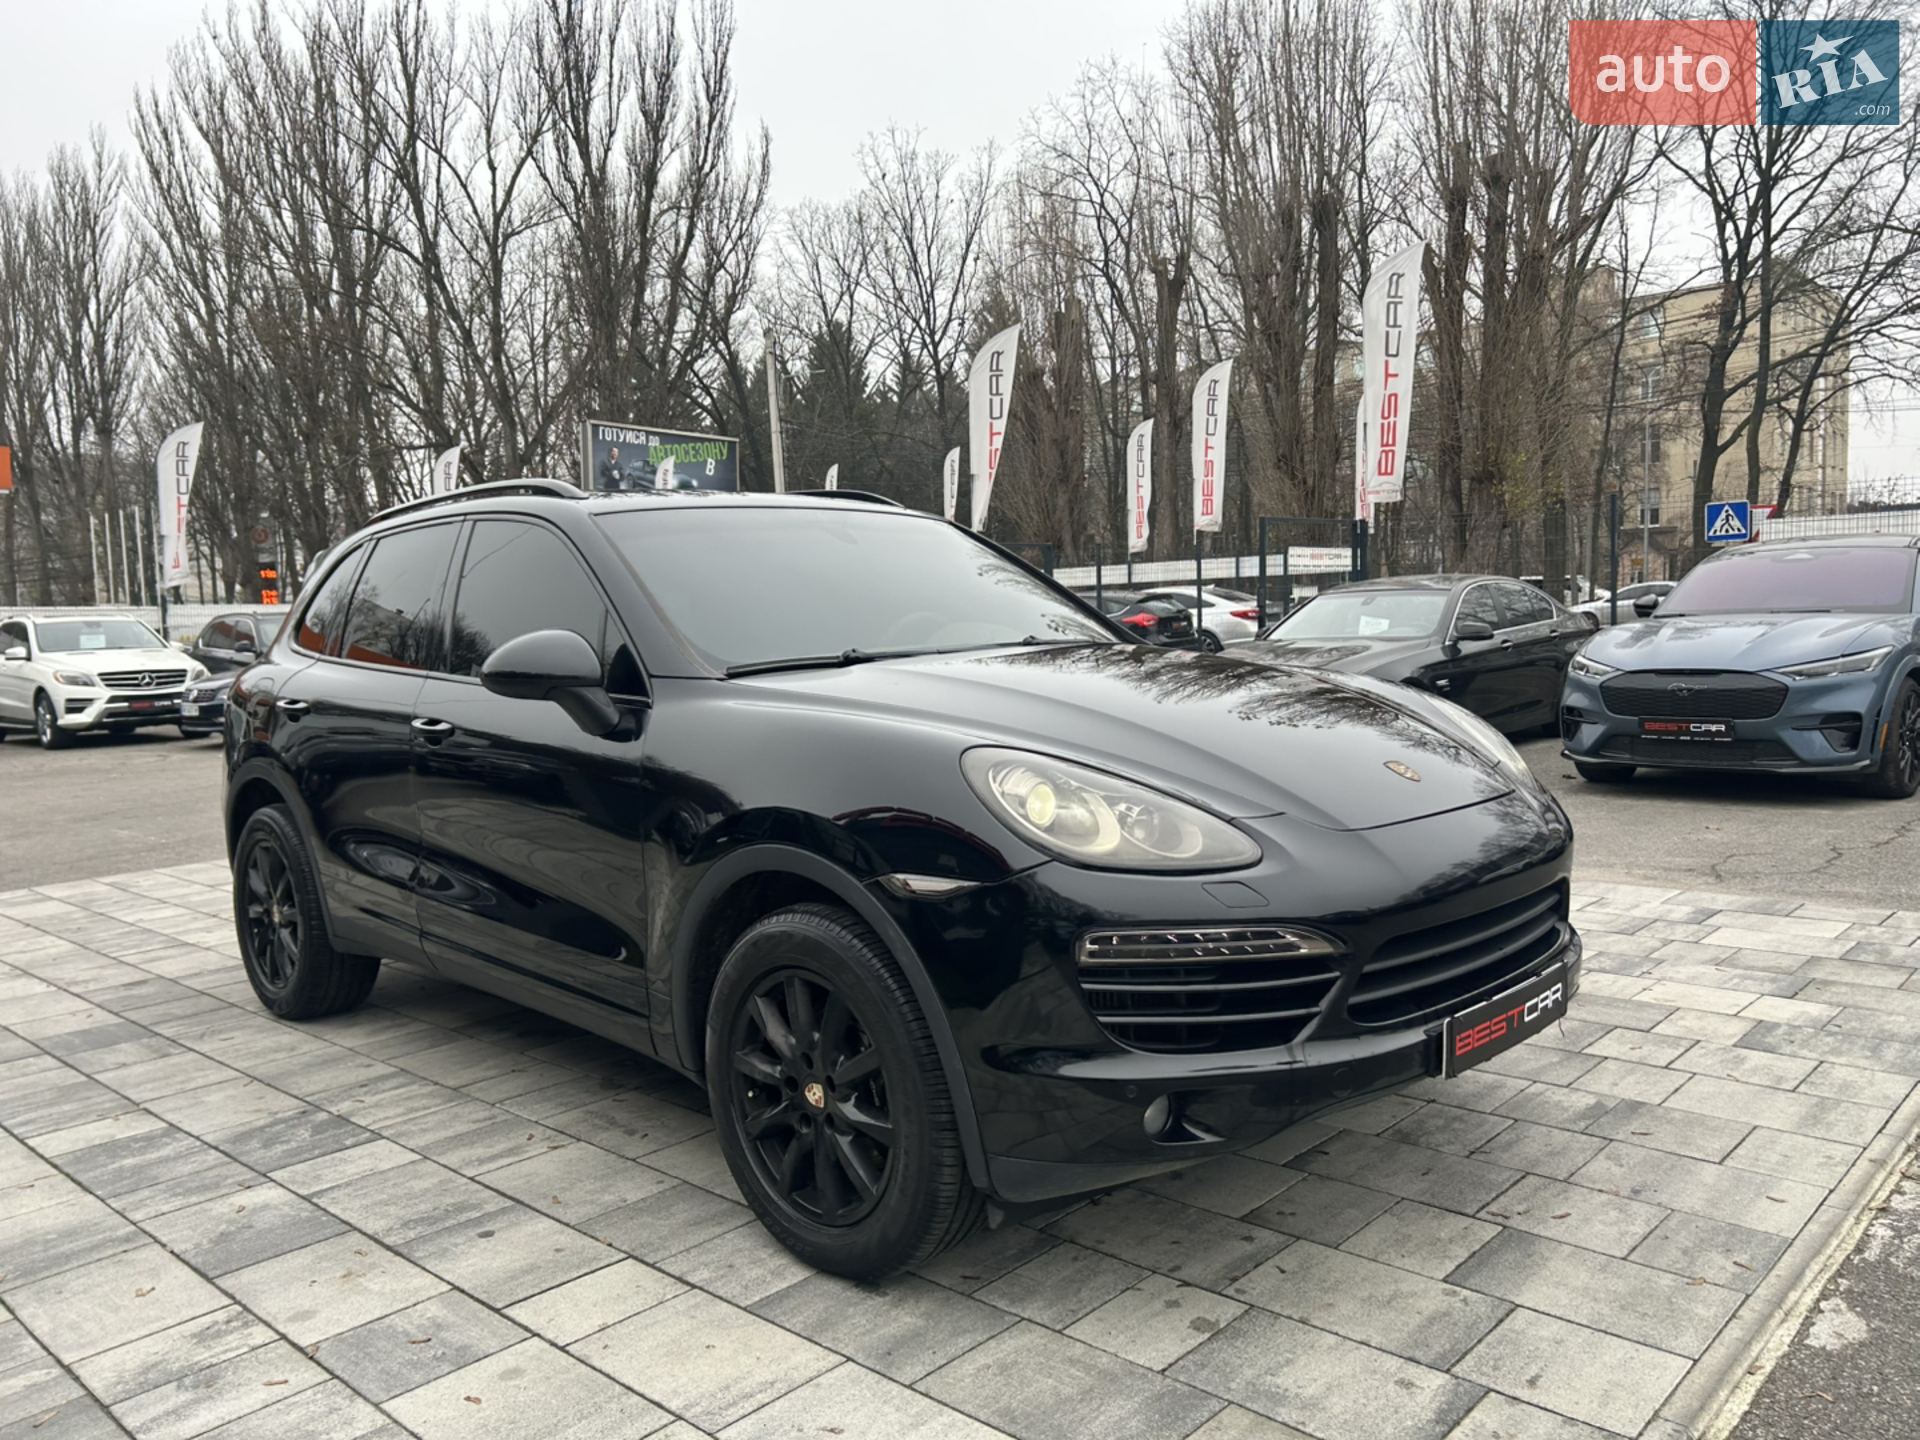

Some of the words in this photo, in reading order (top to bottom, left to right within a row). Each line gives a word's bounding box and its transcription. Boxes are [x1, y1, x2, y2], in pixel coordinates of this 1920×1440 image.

[988, 350, 1004, 484] STCAR
[1377, 272, 1405, 477] BESTCAR
[1201, 378, 1220, 516] BESTCAR
[1644, 722, 1726, 733] BESTCAR
[1455, 982, 1562, 1056] BESTCAR
